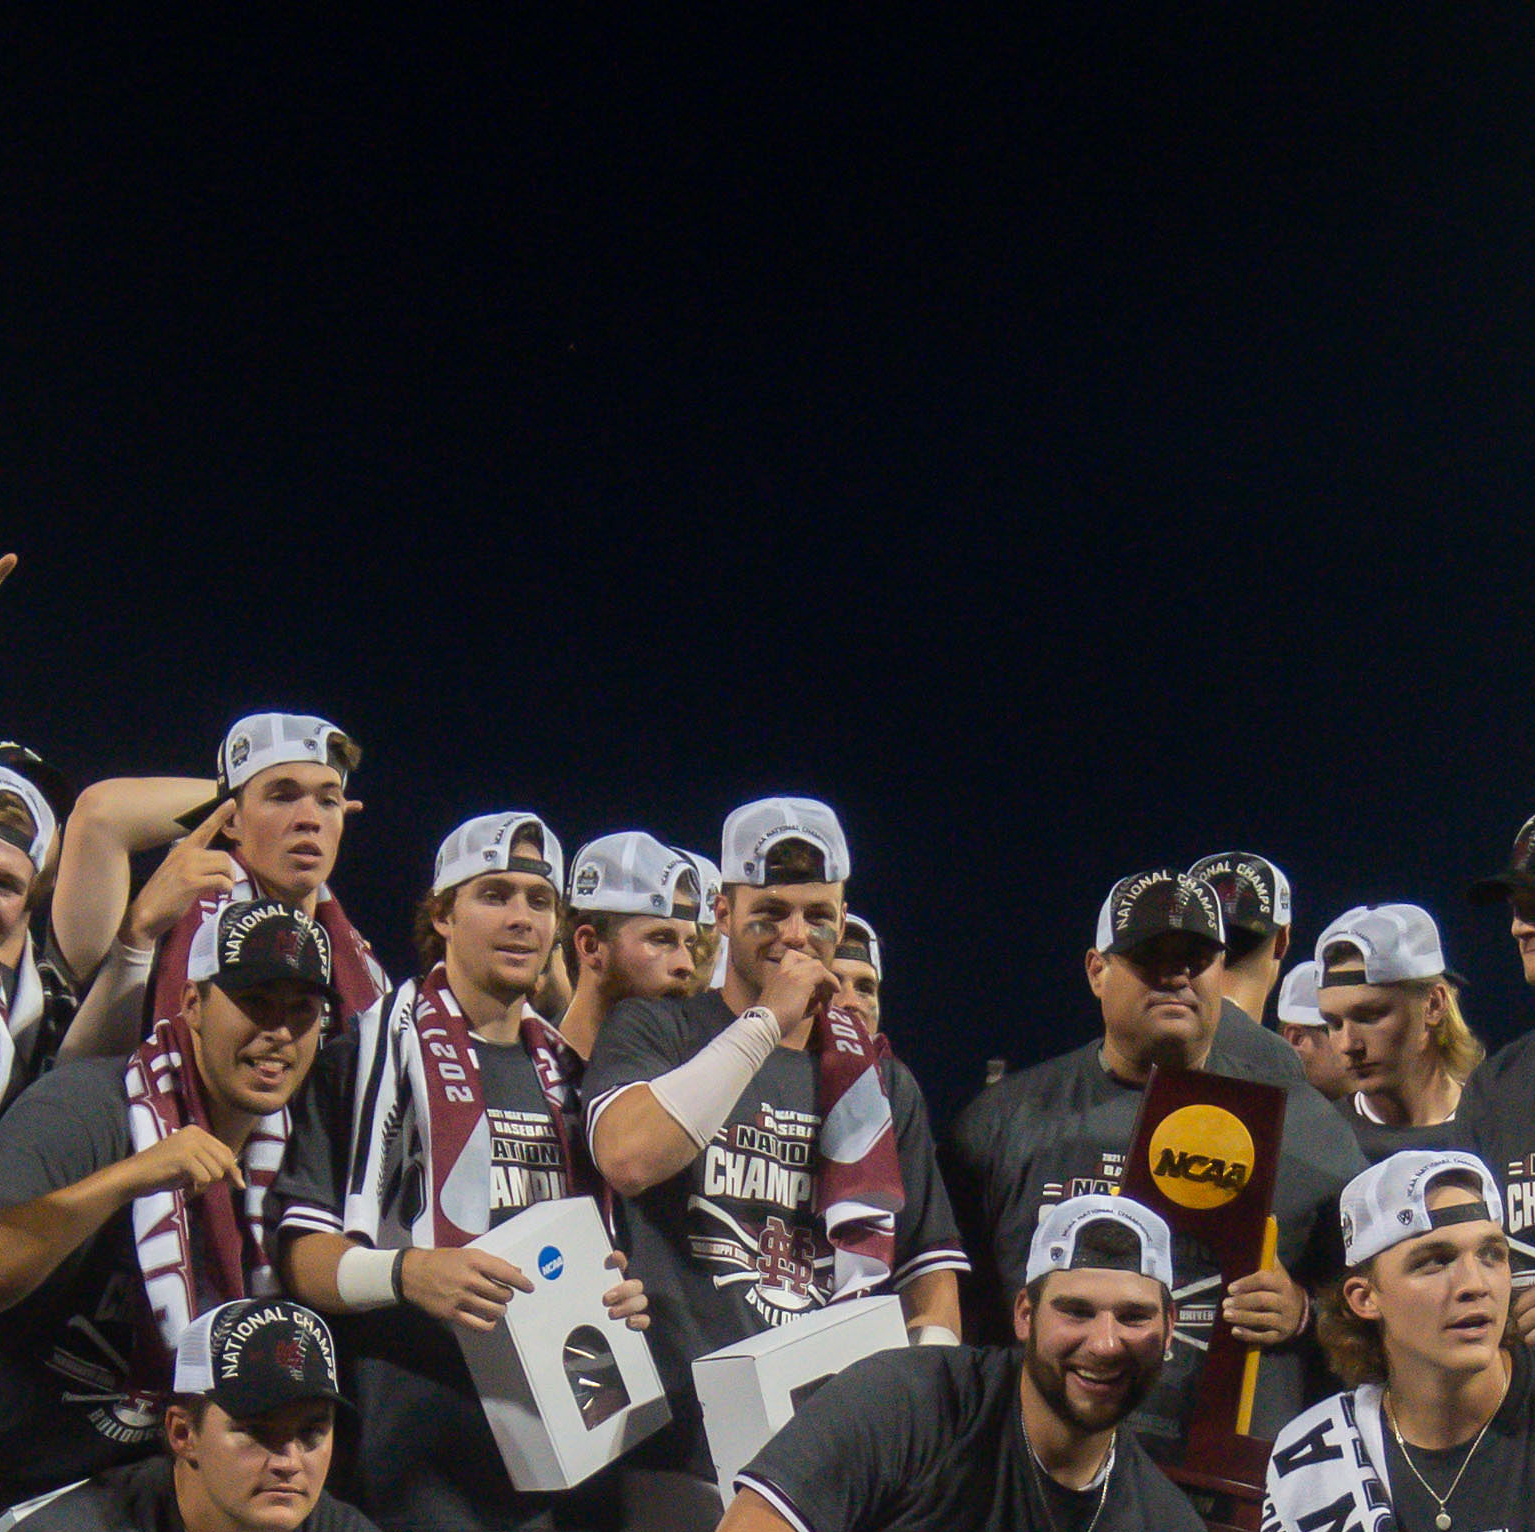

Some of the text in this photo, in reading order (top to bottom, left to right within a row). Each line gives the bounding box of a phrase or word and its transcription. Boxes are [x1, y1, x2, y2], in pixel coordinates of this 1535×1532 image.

[1116, 869, 1217, 931] NATIONAL CHAMPS
[1236, 862, 1270, 914] CHAMPS
[224, 904, 329, 978] NATIONAL CHAMPS
[830, 1007, 864, 1057] 202
[422, 1027, 475, 1103] 2021
[491, 1138, 563, 1164] ATION
[737, 1125, 809, 1165] NATIO
[1153, 1147, 1248, 1189] NCAA
[704, 1145, 812, 1209] CHAMP
[542, 1256, 564, 1277] NCAA
[221, 1306, 335, 1380] NATIONAL CHAMPS
